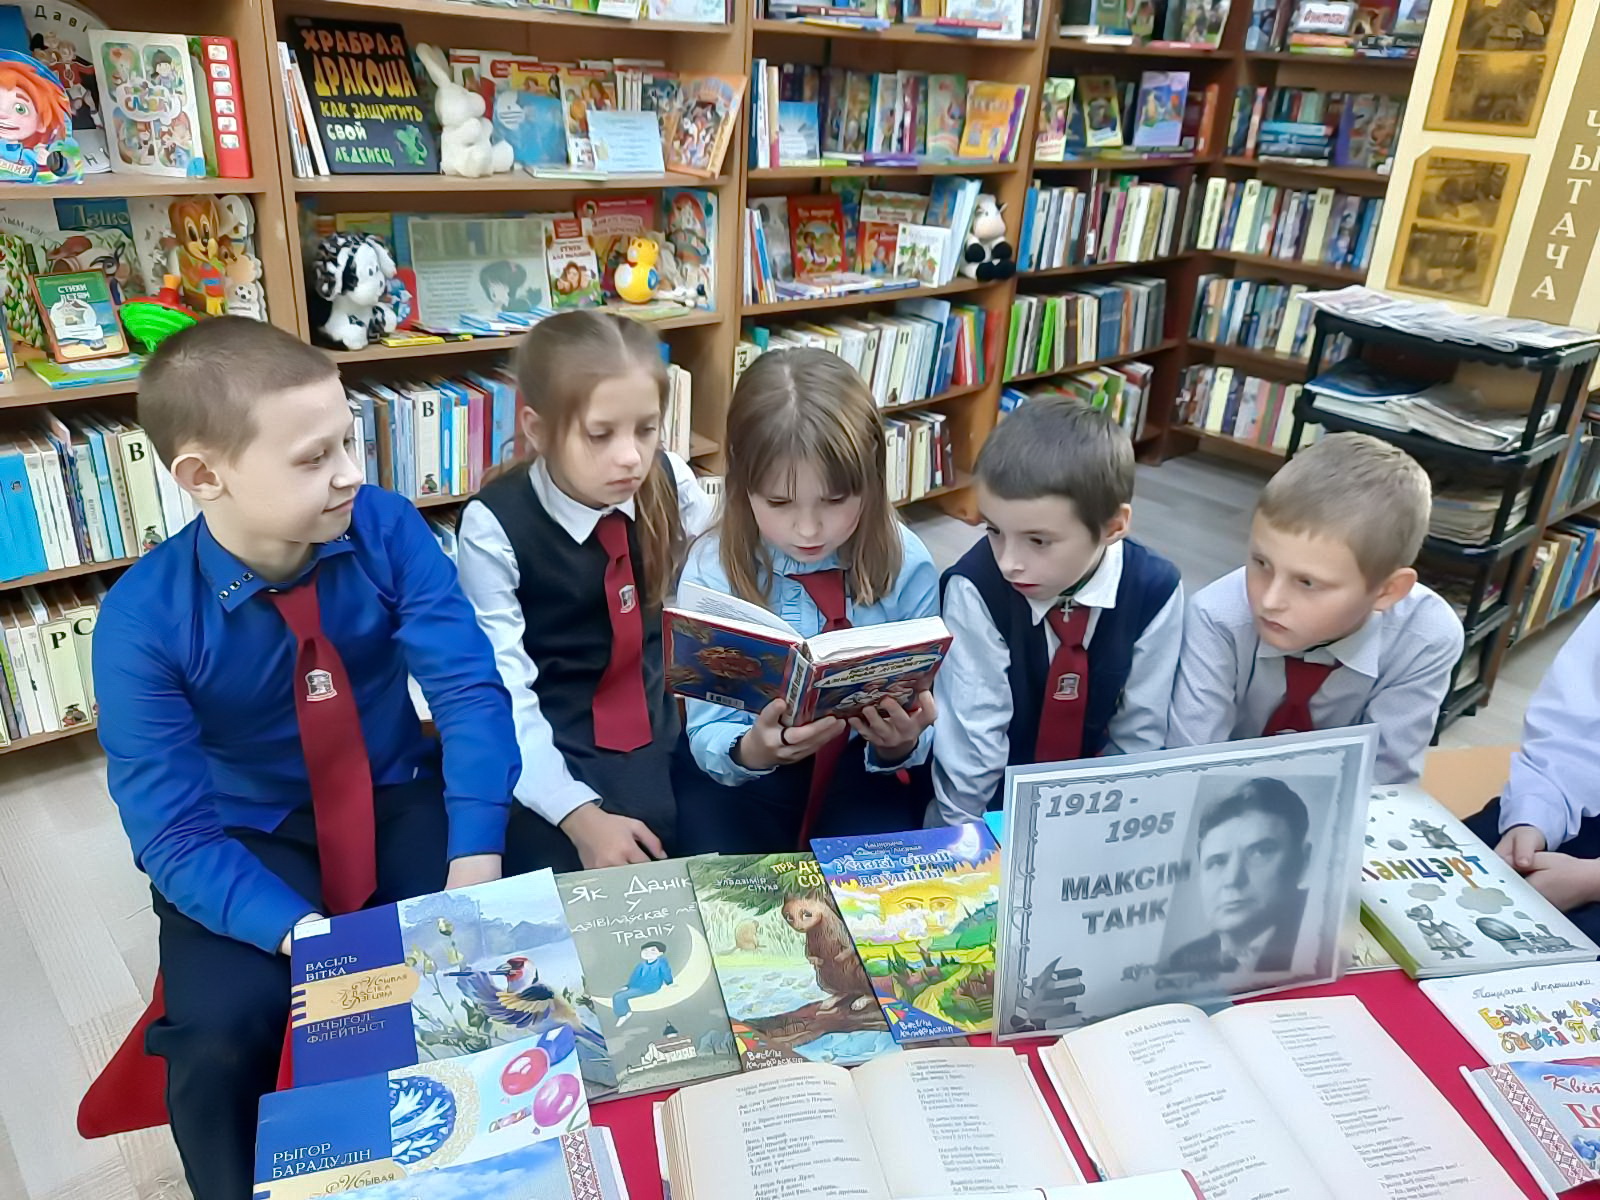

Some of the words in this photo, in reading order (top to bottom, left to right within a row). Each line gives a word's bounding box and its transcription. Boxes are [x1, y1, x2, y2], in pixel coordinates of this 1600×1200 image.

[301, 29, 406, 57] ХРАБРАЯ
[313, 53, 418, 98] ДРАКОША
[320, 101, 350, 118] КАК
[351, 102, 423, 123] ЗАЩИТИТЬ
[326, 121, 367, 141] СВОЙ
[335, 146, 395, 168] ЛЕДЕНЕЦ
[421, 400, 435, 418] В
[128, 442, 145, 463] В
[73, 617, 94, 636] С
[49, 631, 67, 650] Р
[1045, 789, 1124, 818] 1912
[1104, 811, 1177, 844] 1995
[567, 886, 609, 905] Як
[623, 874, 693, 898] Данік
[1061, 859, 1192, 902] МАКСІМ
[1081, 897, 1169, 935] ТАНК
[305, 955, 358, 972] ВАСІЛЬ
[305, 966, 347, 982] ВІТКА
[306, 1019, 387, 1044] ФЛЕЙТЫСТ
[272, 1148, 371, 1180] БАРАДУЛІН
[273, 1143, 331, 1165] РЫГОР
